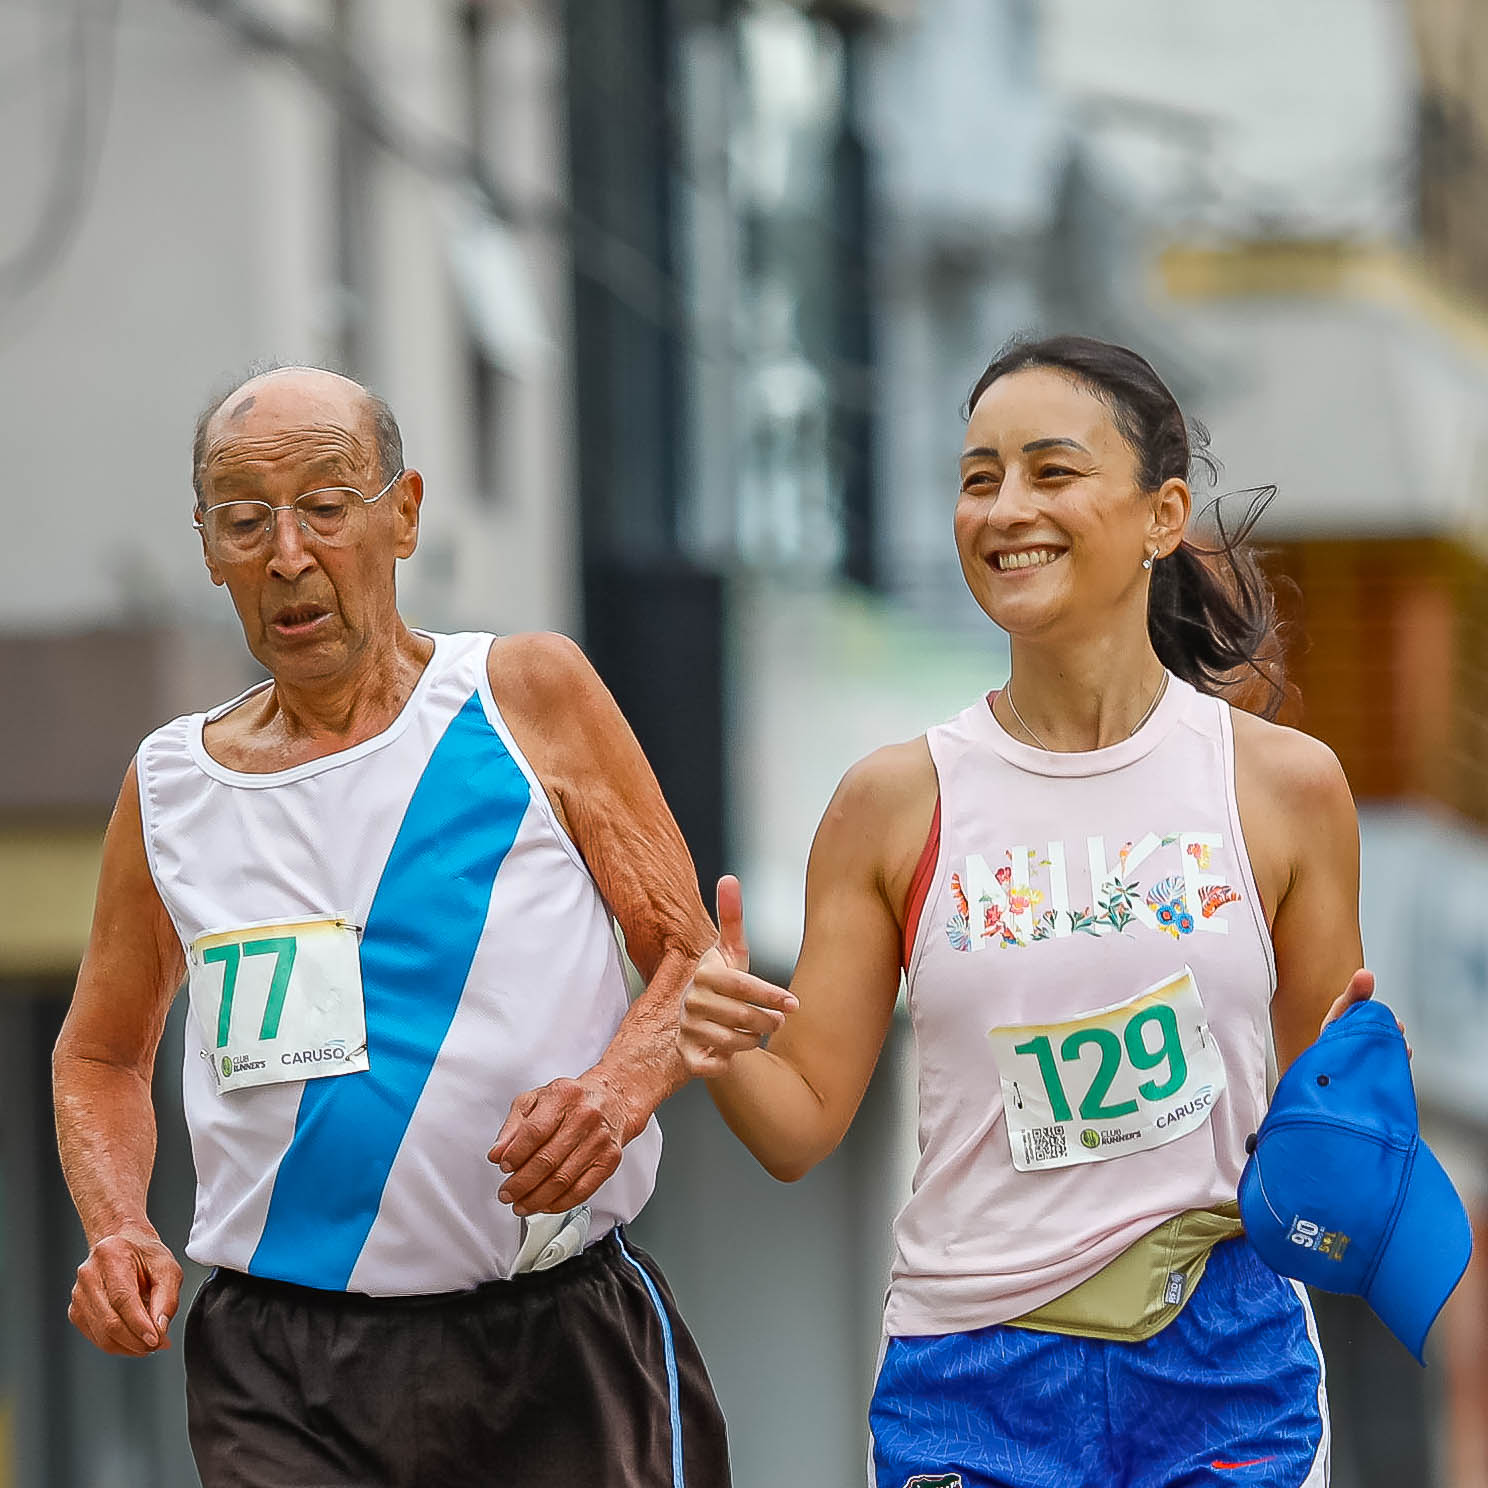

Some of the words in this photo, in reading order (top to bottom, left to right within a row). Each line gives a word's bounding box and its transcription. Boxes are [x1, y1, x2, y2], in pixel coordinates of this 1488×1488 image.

[962, 831, 1234, 952] NIKE
[203, 936, 296, 1048] 77
[281, 1047, 345, 1065] CARUSO
[1015, 1004, 1188, 1122] 129
